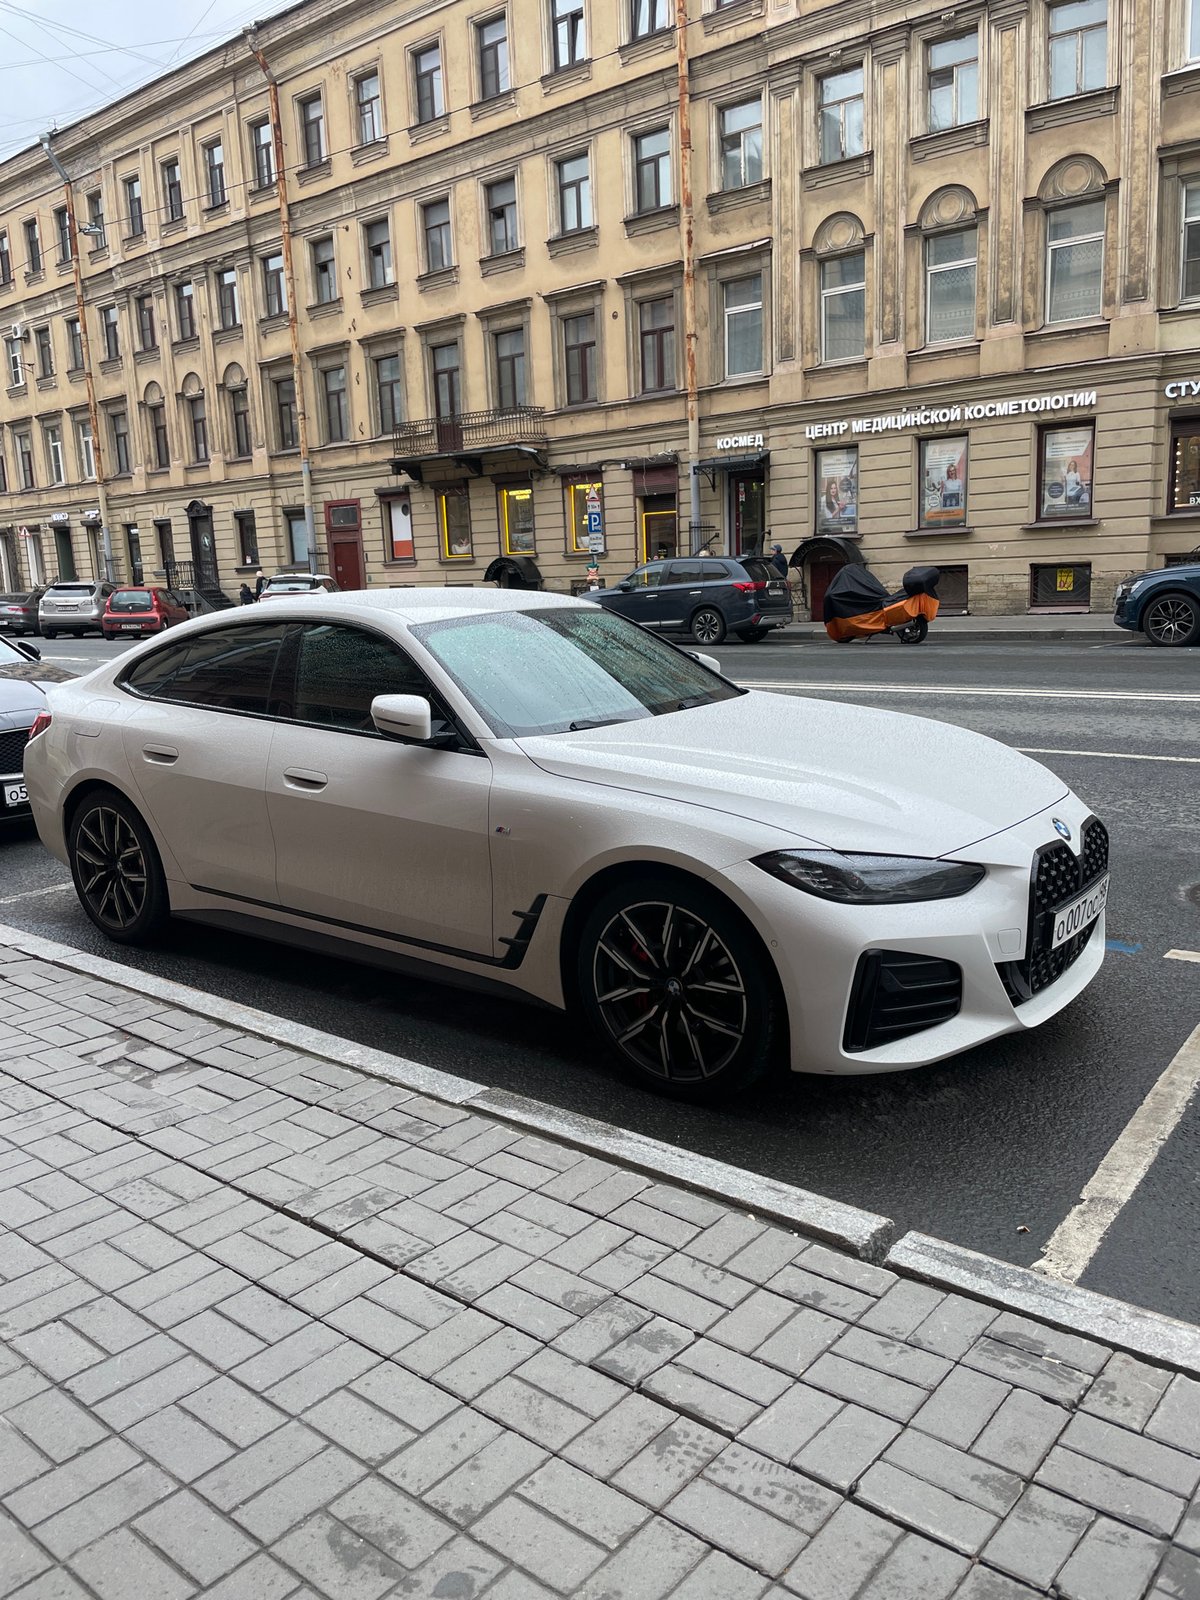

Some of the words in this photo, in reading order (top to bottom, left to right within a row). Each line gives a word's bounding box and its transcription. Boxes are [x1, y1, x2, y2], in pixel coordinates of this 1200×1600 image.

[805, 422, 848, 439] ЦЕНТР
[851, 404, 961, 434] МЕДИЦИНСКОЙ
[964, 391, 1097, 420] КОСМЕТОЛОГИИ
[716, 433, 764, 449] КОСМЕД
